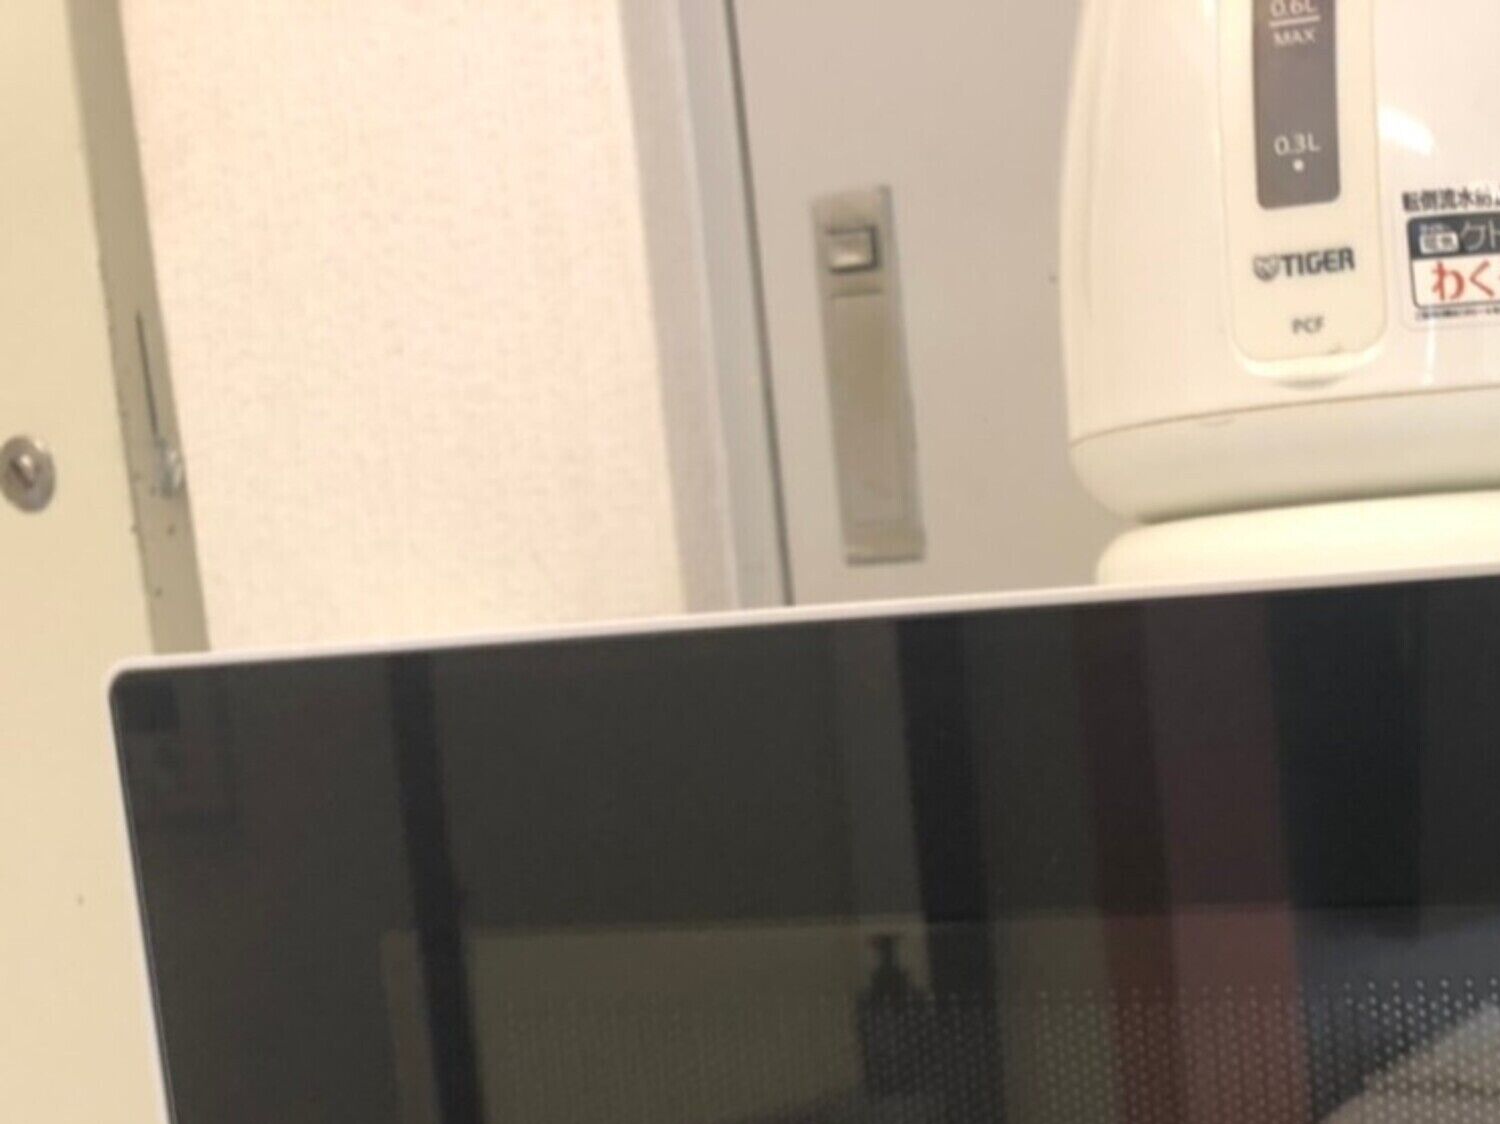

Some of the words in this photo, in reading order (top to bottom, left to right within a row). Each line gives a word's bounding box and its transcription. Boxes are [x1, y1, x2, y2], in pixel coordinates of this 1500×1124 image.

[1272, 28, 1317, 46] MAX
[1272, 132, 1321, 156] 0.3L
[1281, 246, 1356, 278] TIGER
